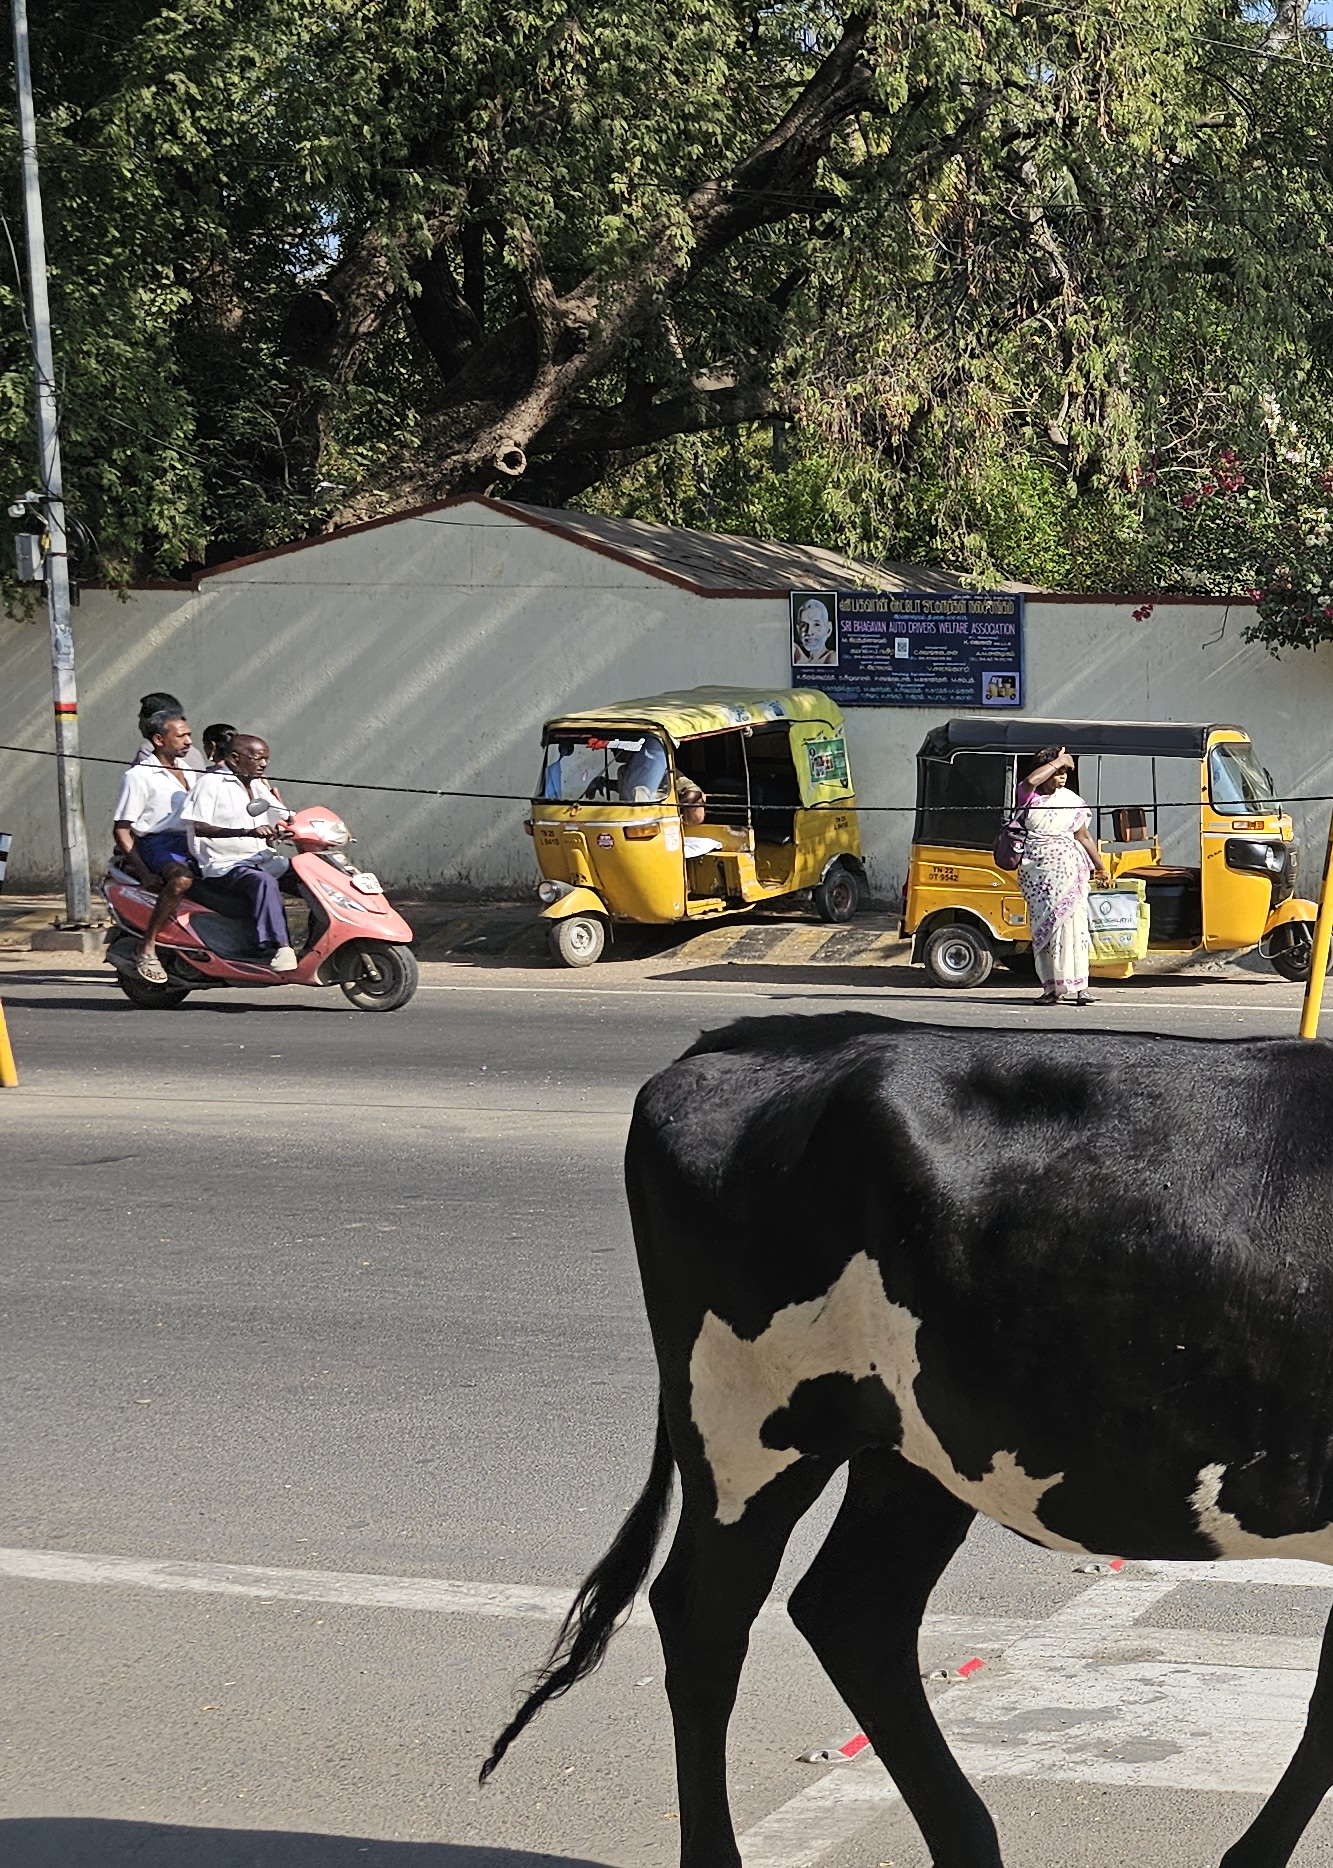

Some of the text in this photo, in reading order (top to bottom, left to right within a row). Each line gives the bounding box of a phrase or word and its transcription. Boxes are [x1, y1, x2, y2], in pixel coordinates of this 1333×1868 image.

[841, 620, 1016, 635] SRI BHAGAVAN AUTO DRIVERS WELFARE ASSOCIATION
